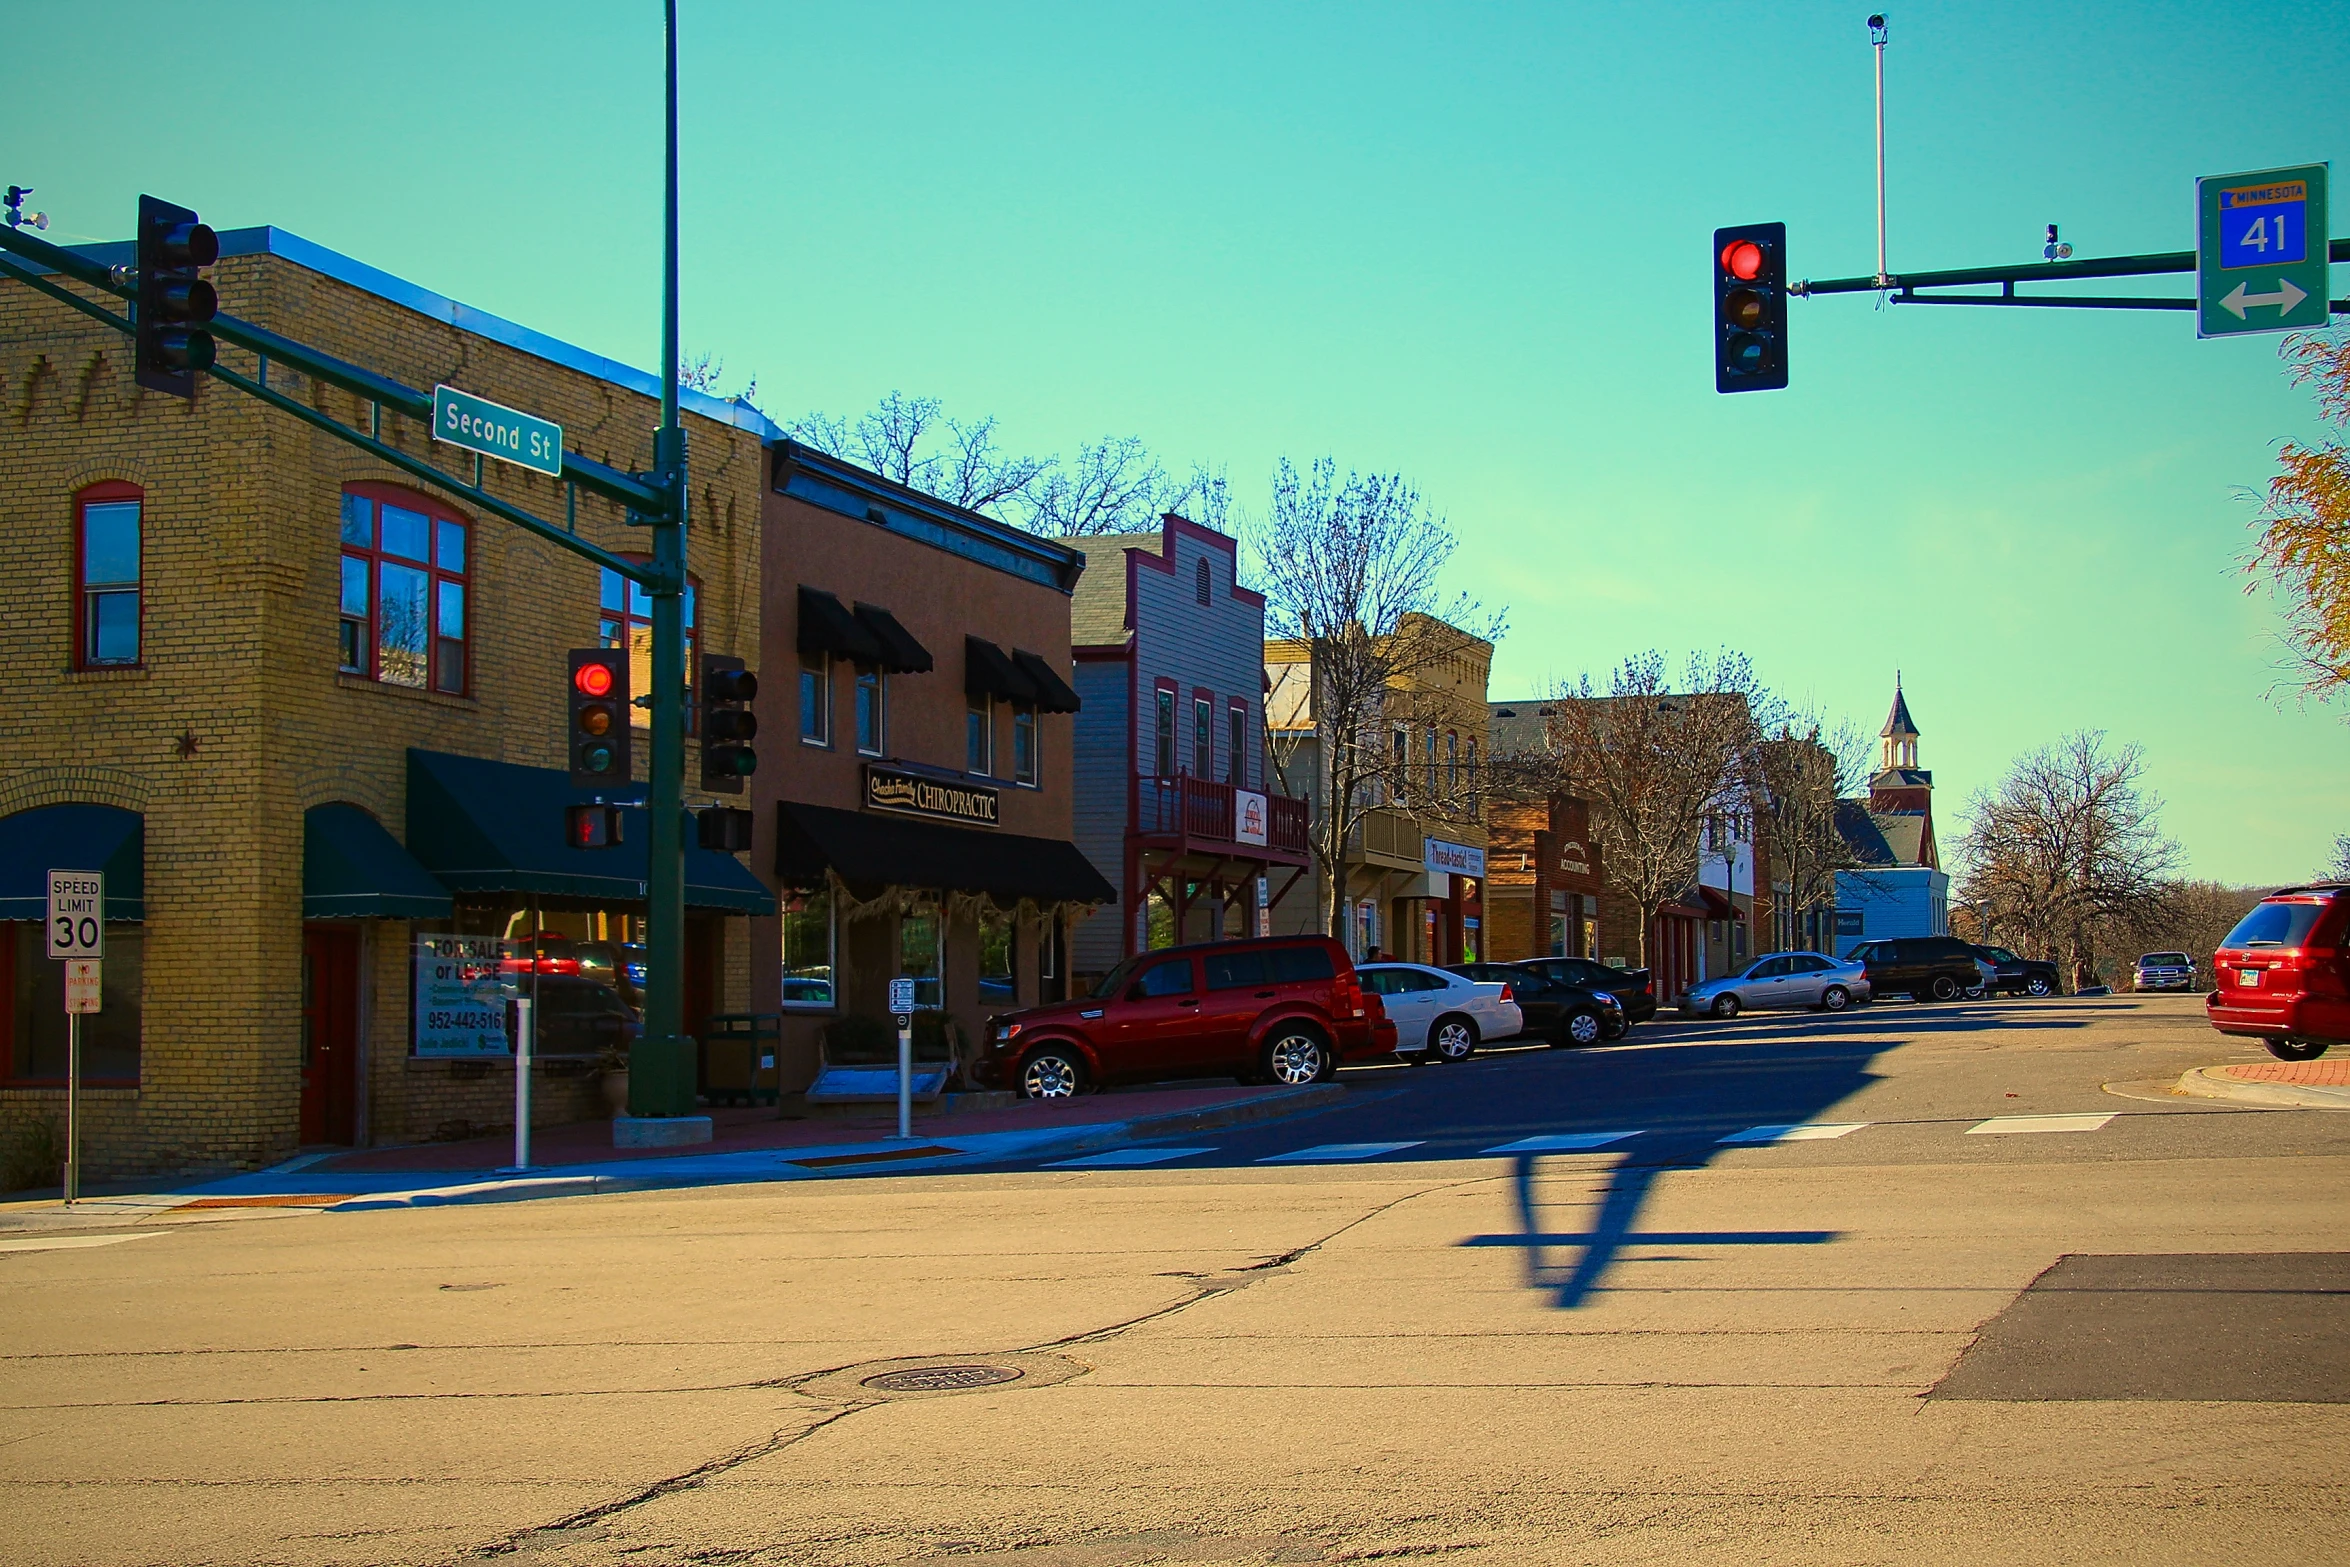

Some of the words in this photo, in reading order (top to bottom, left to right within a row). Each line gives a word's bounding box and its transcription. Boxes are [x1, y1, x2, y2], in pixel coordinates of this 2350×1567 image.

[2236, 185, 2304, 204] MINNESOTA
[2240, 214, 2285, 253] 41
[446, 402, 520, 451] Second
[530, 431, 551, 461] St
[895, 778, 917, 802] Family
[917, 781, 996, 820] CHIROPRACTIC
[1560, 858, 1590, 875] ACCOUNTING
[53, 880, 99, 895] SPEED
[58, 899, 94, 913] LIMIT
[1837, 918, 1860, 927] Herald
[54, 916, 99, 949] 30
[433, 938, 464, 958] FOR
[468, 940, 505, 960] SALE
[77, 964, 90, 975] NO
[435, 965, 452, 980] or
[455, 962, 502, 981] LEASE
[69, 977, 99, 987] PARKING
[69, 997, 99, 1008] STOPPING
[429, 1011, 505, 1030] 952-442-516
